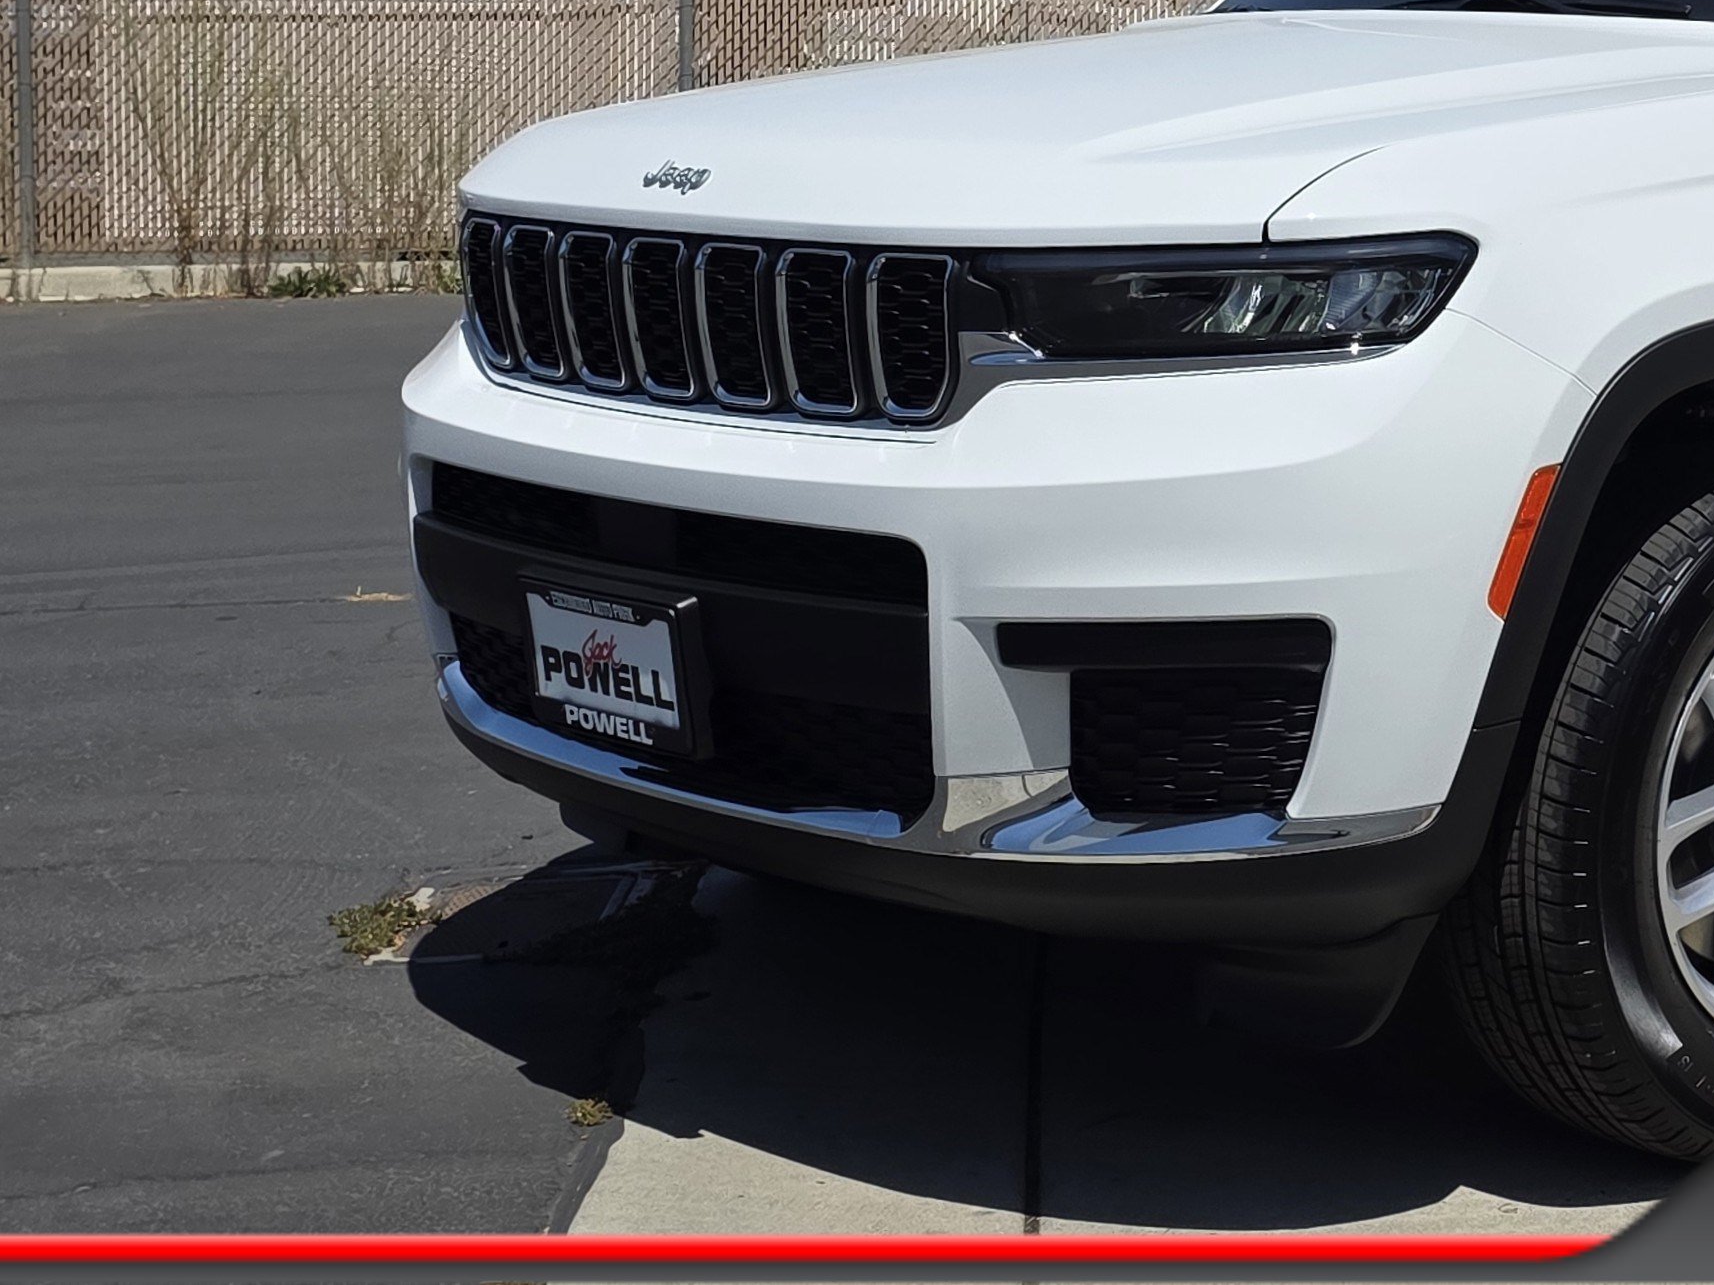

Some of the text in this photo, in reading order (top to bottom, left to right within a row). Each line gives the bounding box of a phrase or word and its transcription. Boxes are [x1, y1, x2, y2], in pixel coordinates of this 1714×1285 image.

[642, 159, 711, 195] Jeep
[582, 629, 622, 679] Jack
[541, 645, 675, 711] POWELL
[564, 704, 653, 745] POWELL
